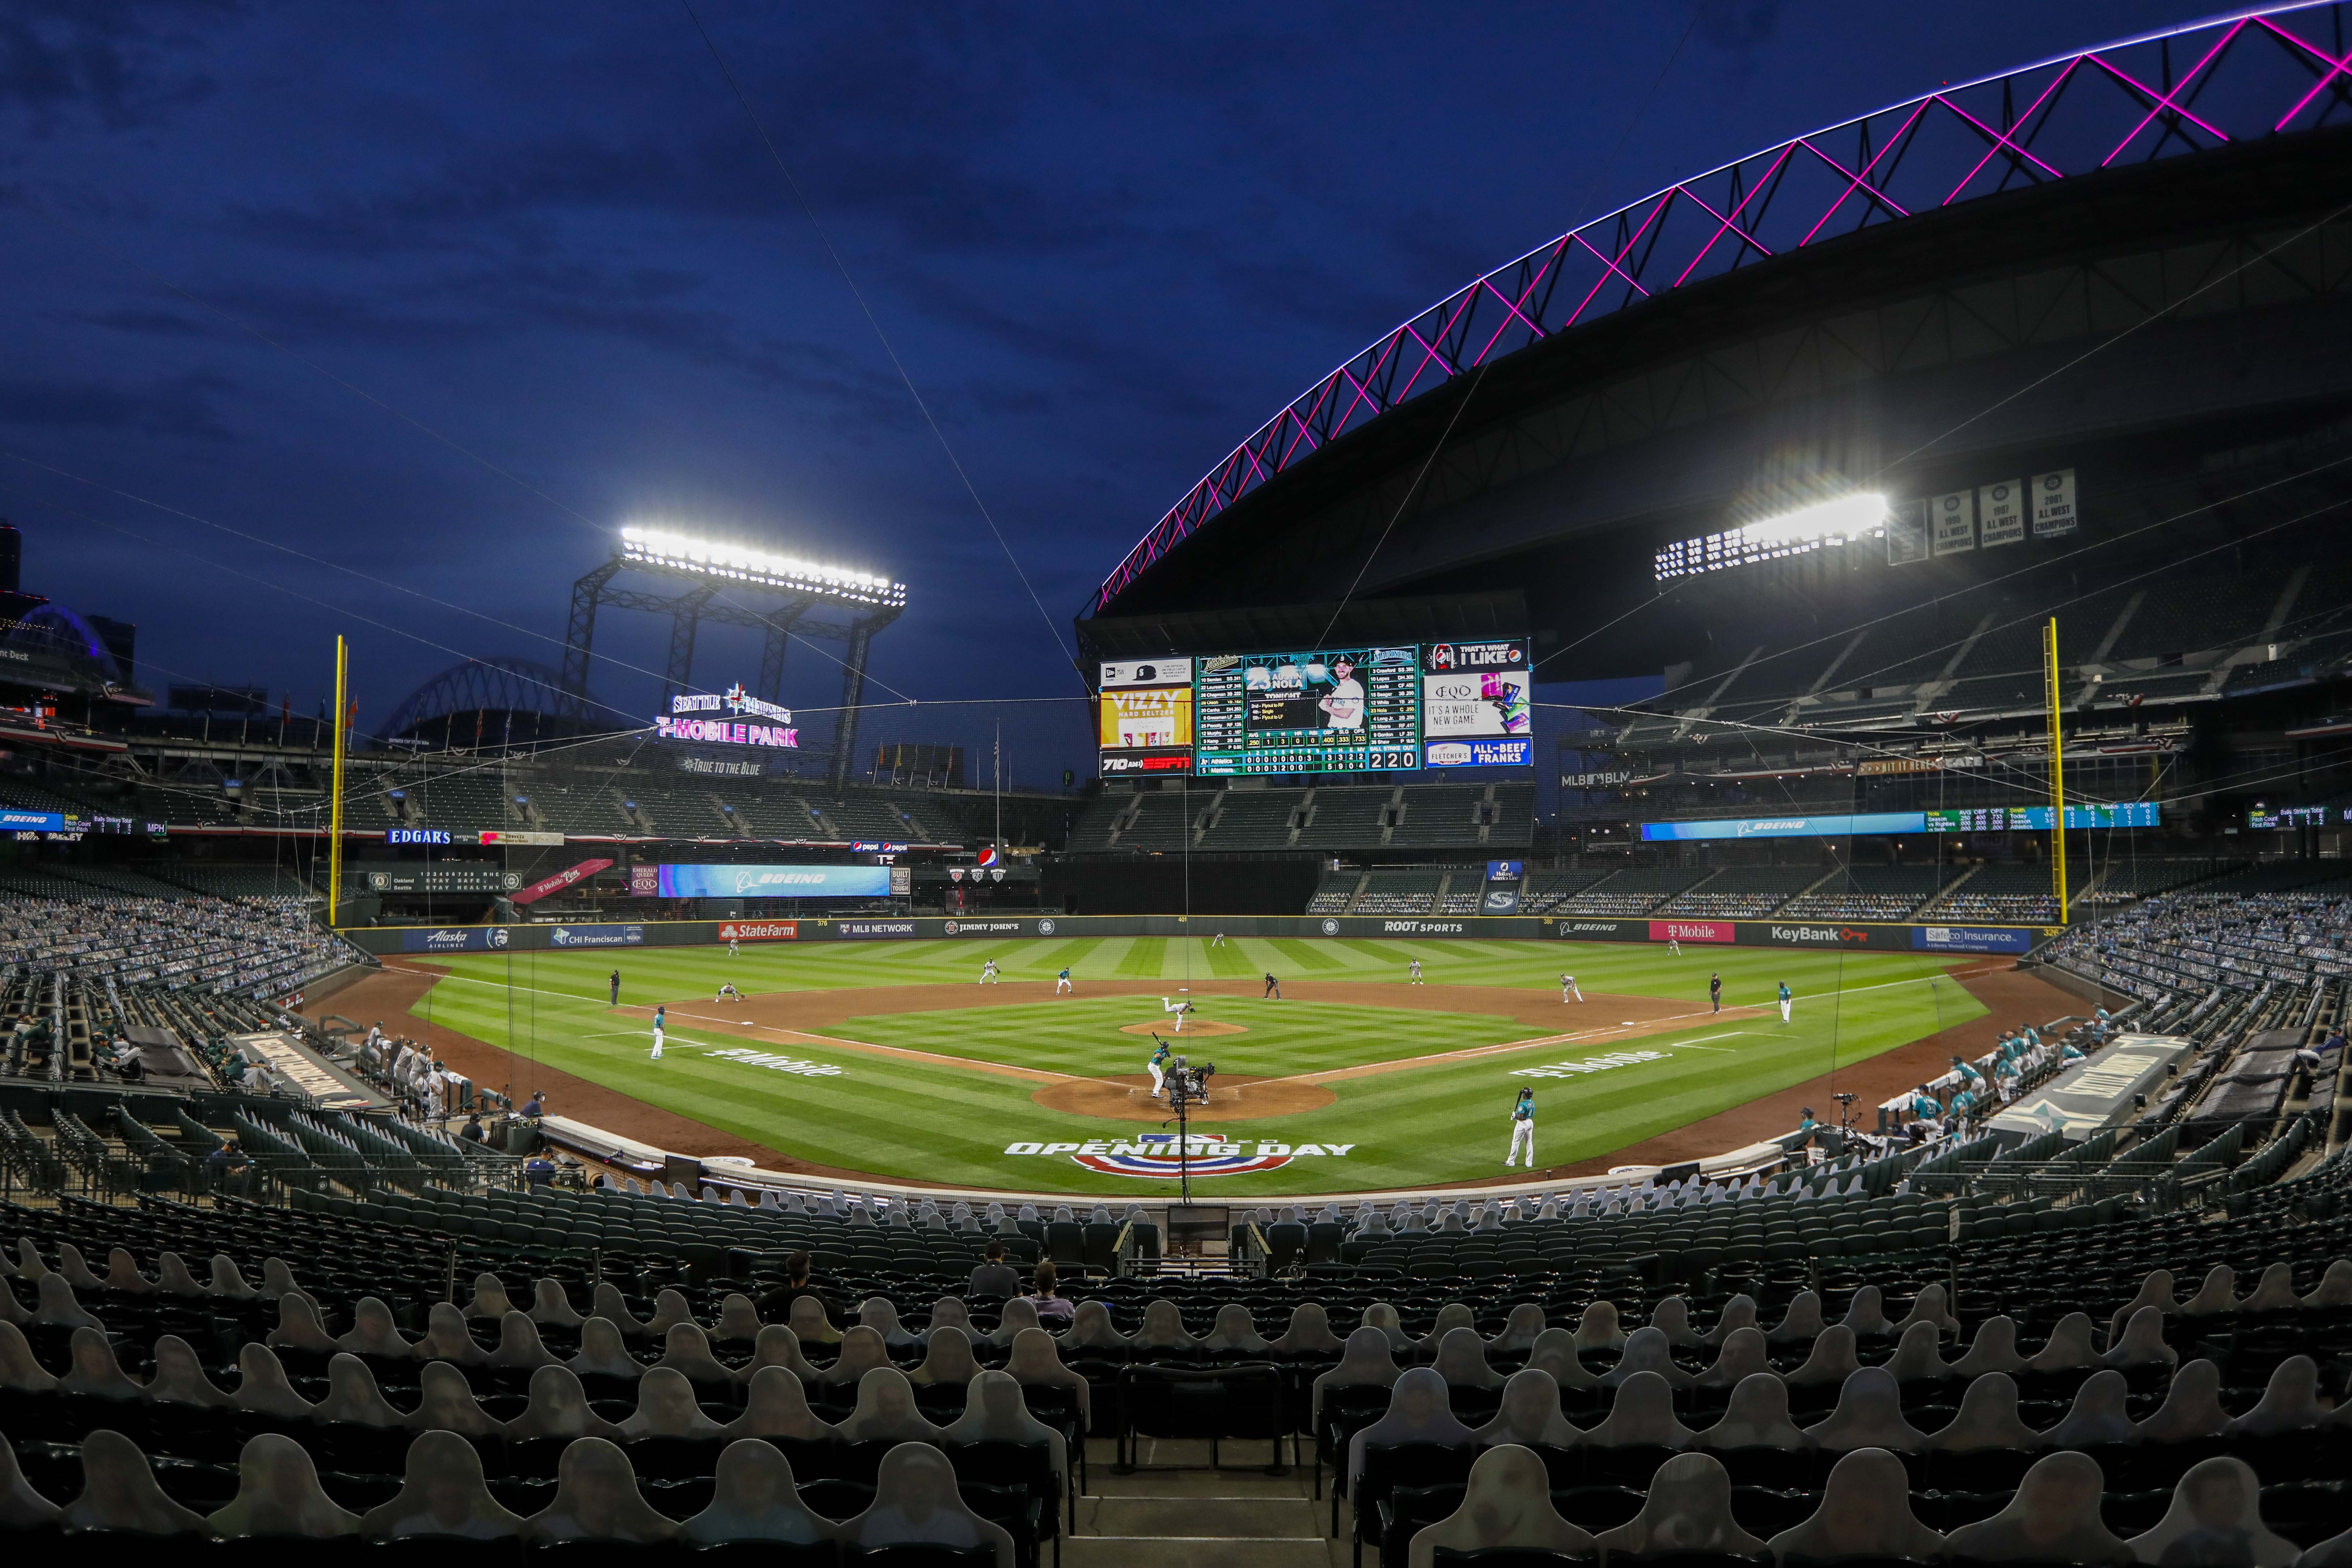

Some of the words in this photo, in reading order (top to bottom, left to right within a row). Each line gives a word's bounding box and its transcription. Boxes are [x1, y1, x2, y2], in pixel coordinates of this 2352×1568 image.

[2051, 505, 2070, 516] WEST
[1998, 515, 2017, 527] WEST
[2035, 517, 2075, 532] CHAMPIONS
[1950, 525, 1968, 536] WEST
[1983, 528, 2022, 543] CHAMPIONS
[10, 651, 29, 661] Deck
[1460, 653, 1466, 665] I
[1471, 651, 1507, 664] LIKE
[1247, 674, 1271, 690] 23
[1273, 680, 1303, 689] NOLA
[1111, 691, 1179, 710] VIZZY
[673, 695, 720, 713] SEATTLE
[745, 696, 791, 724] MARINERS
[1429, 706, 1443, 715] IT'S
[1452, 705, 1479, 714] WHOLE
[1434, 716, 1450, 725] NEW
[1453, 715, 1475, 724] GAME
[656, 716, 746, 744] T-MOBILE
[749, 724, 798, 748] PARK
[1473, 743, 1526, 753] ALL-BEEF
[1103, 758, 1128, 770] 710
[1142, 757, 1190, 769] ESPN
[1372, 753, 1381, 768] 2
[1388, 753, 1397, 767] 2
[1404, 752, 1413, 767] 0
[1479, 754, 1521, 763] FRANKS
[694, 758, 712, 772] TRUE
[715, 762, 724, 773] TO
[726, 762, 739, 774] THE
[741, 763, 760, 775] BLUE
[1899, 762, 1907, 771] IT
[1562, 775, 1586, 786] MLB
[1606, 772, 1629, 783] BLM
[3, 815, 47, 823] BOEING
[148, 824, 164, 832] MPH
[1754, 821, 1805, 830] BOEING
[392, 831, 450, 844] EDGAR'S
[758, 873, 826, 883] BOEING
[544, 879, 563, 890] Mobile
[853, 925, 870, 933] MLB
[872, 924, 912, 933] NETWORK
[960, 924, 988, 932] JIMMY
[1385, 921, 1419, 931] ROOT
[1420, 924, 1462, 933] SPORTS
[1573, 923, 1617, 931] BOEING
[1679, 925, 1715, 938] Mobile
[427, 930, 468, 942] Alaska
[1772, 927, 1839, 942] KeyBank
[1929, 930, 1960, 940] Safeco
[1964, 931, 2012, 941] Insurance
[2043, 929, 2059, 937] 326
[1003, 1143, 1240, 1156] OPENING
[1256, 1144, 1356, 1156] DAY
